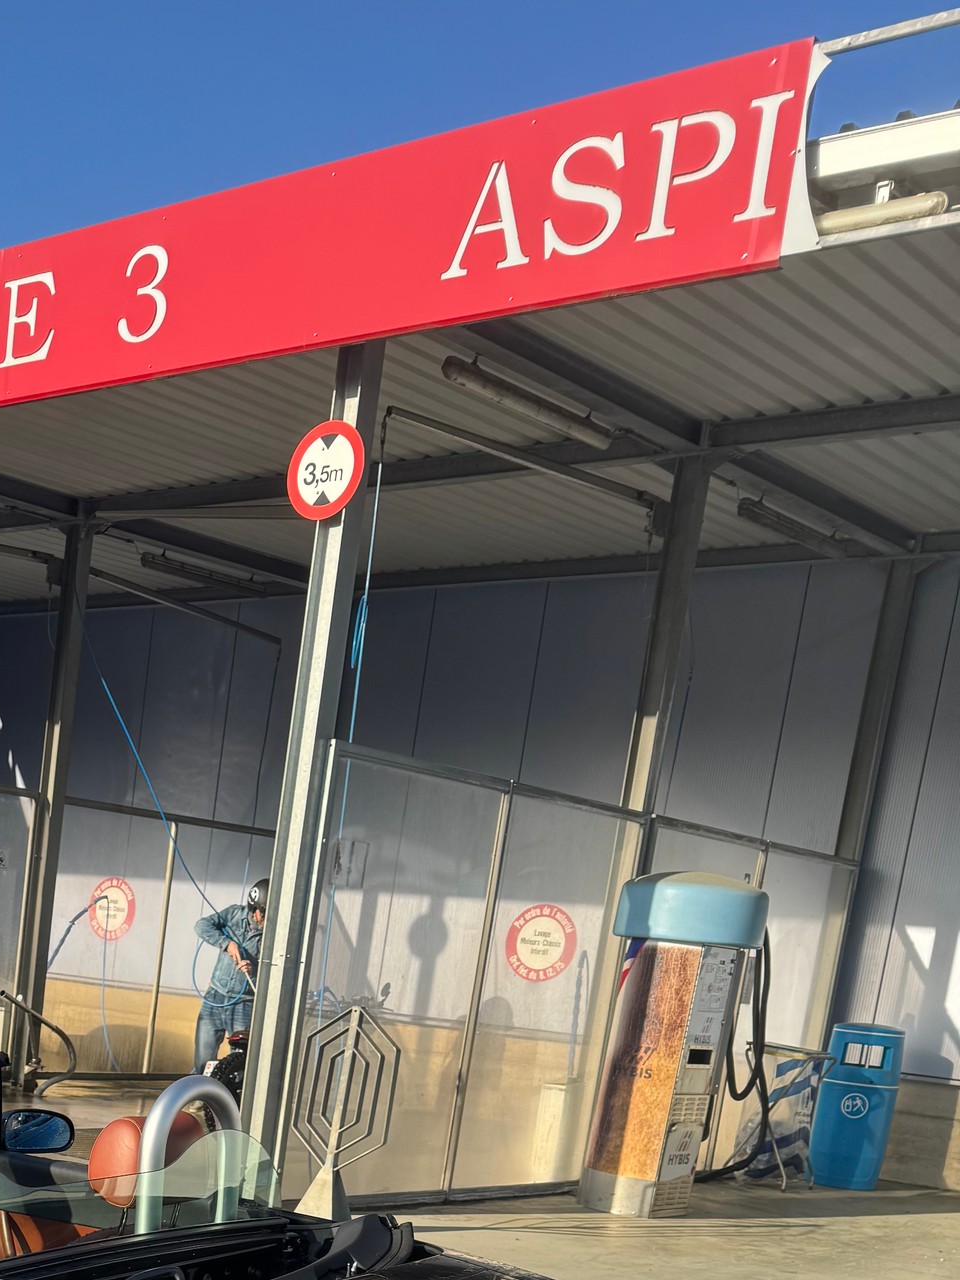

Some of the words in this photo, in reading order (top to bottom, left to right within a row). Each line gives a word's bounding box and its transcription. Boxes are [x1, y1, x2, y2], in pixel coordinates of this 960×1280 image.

[440, 90, 795, 281] ASPI
[117, 244, 169, 343] 3
[303, 462, 344, 488] 3,5m
[668, 1153, 690, 1165] HYBIS
